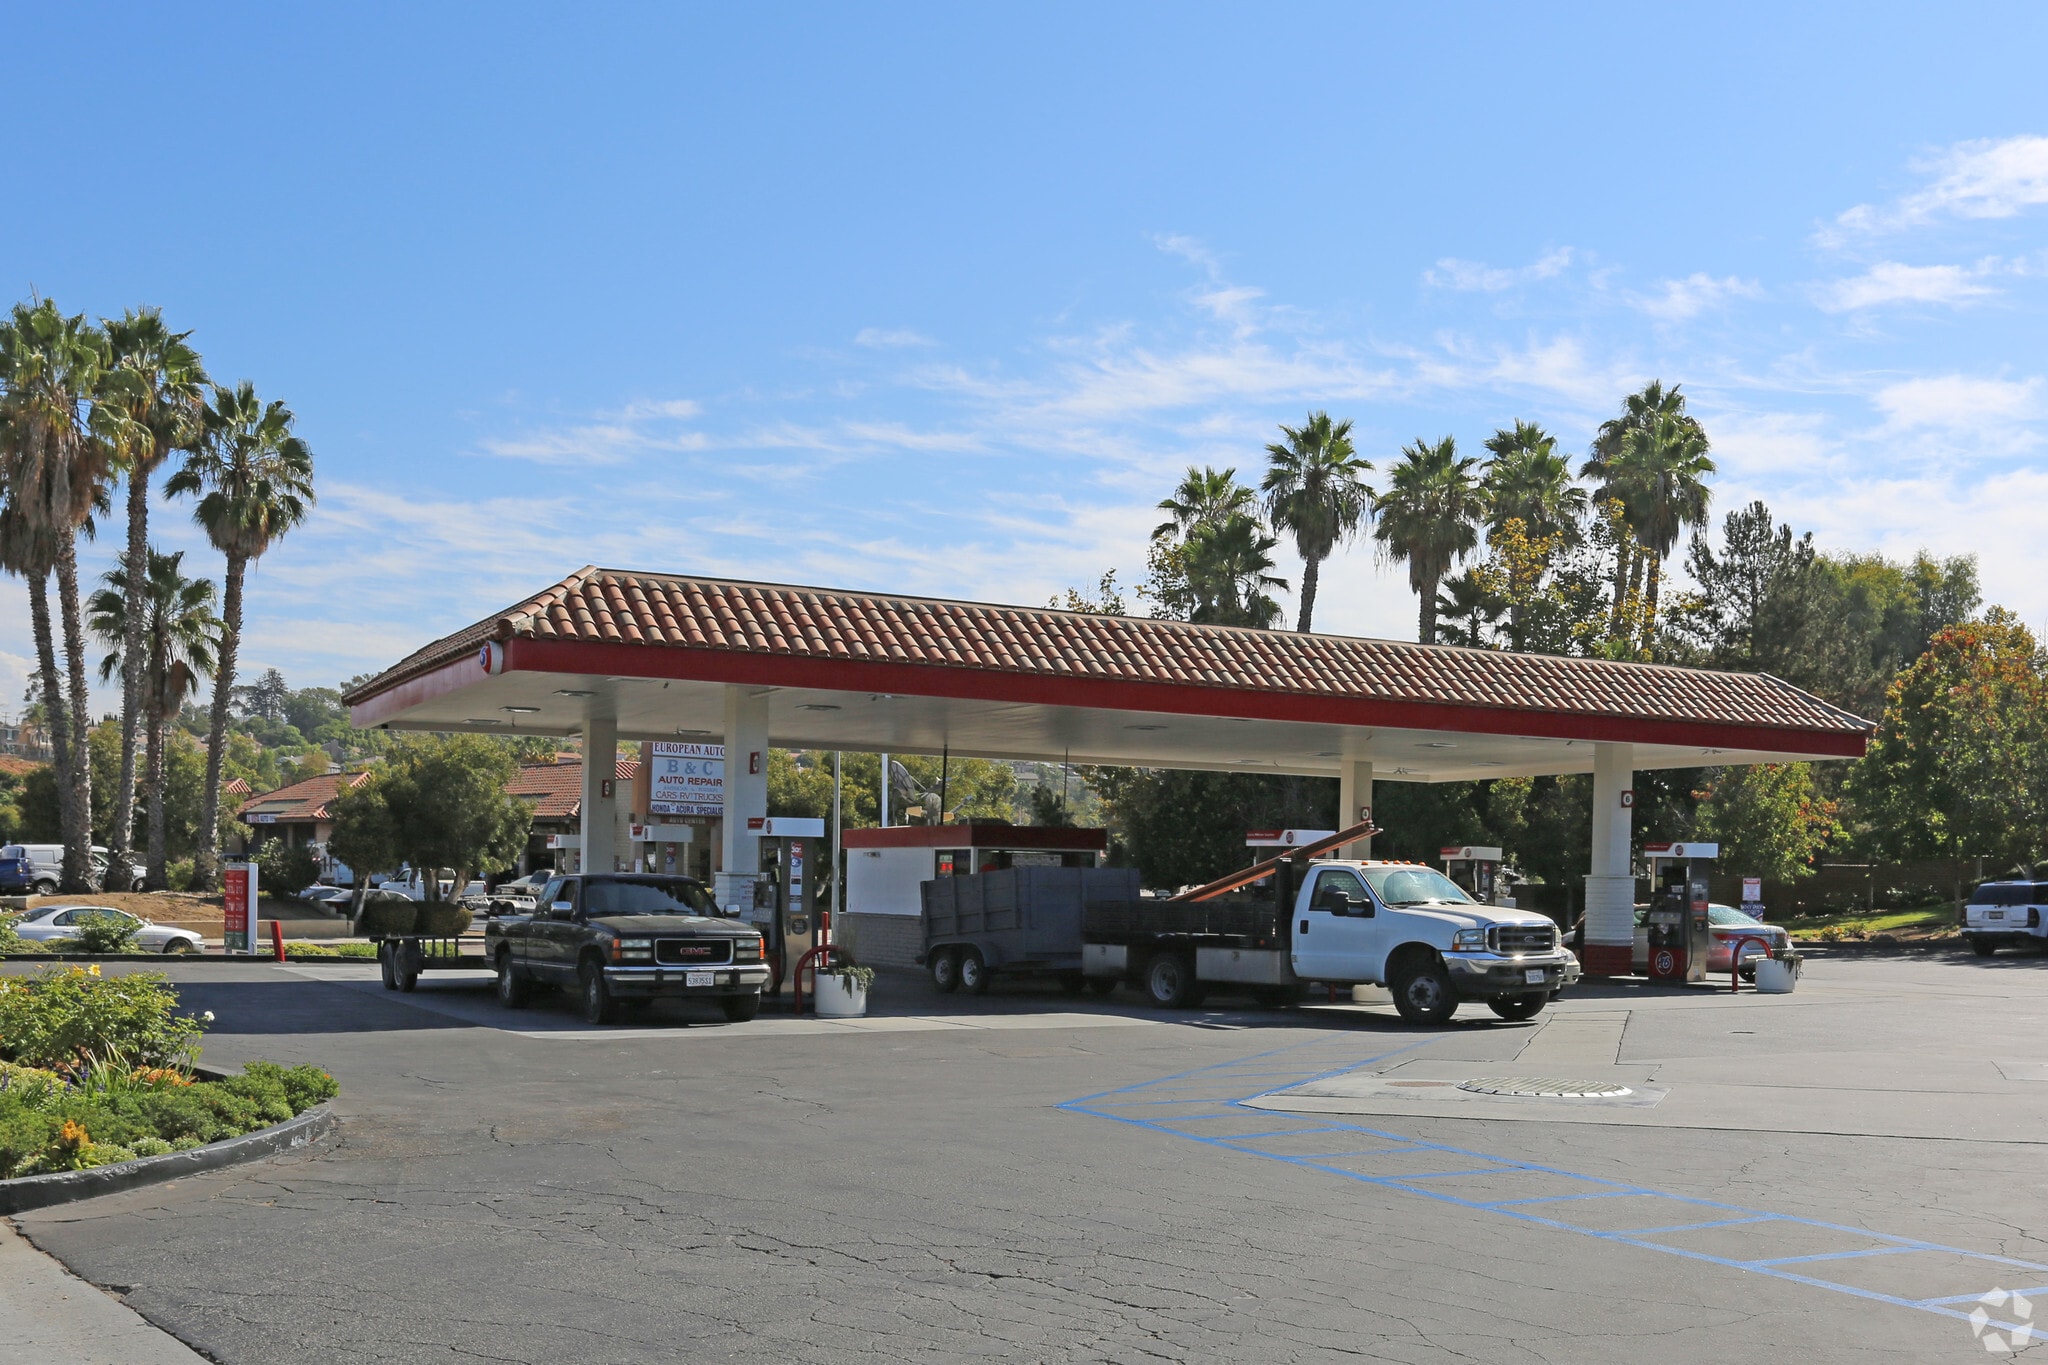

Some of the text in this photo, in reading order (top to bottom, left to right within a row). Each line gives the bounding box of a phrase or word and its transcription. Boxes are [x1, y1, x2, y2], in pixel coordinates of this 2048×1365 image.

[655, 742, 701, 754] EUROPEAN
[667, 760, 714, 776] B & C
[658, 776, 723, 787] AUTO REPAIR
[656, 791, 677, 799] CARS
[694, 792, 724, 802] TRUCKS
[652, 804, 671, 813] HONDA
[676, 805, 695, 814] ACURA
[680, 947, 711, 956] GMC
